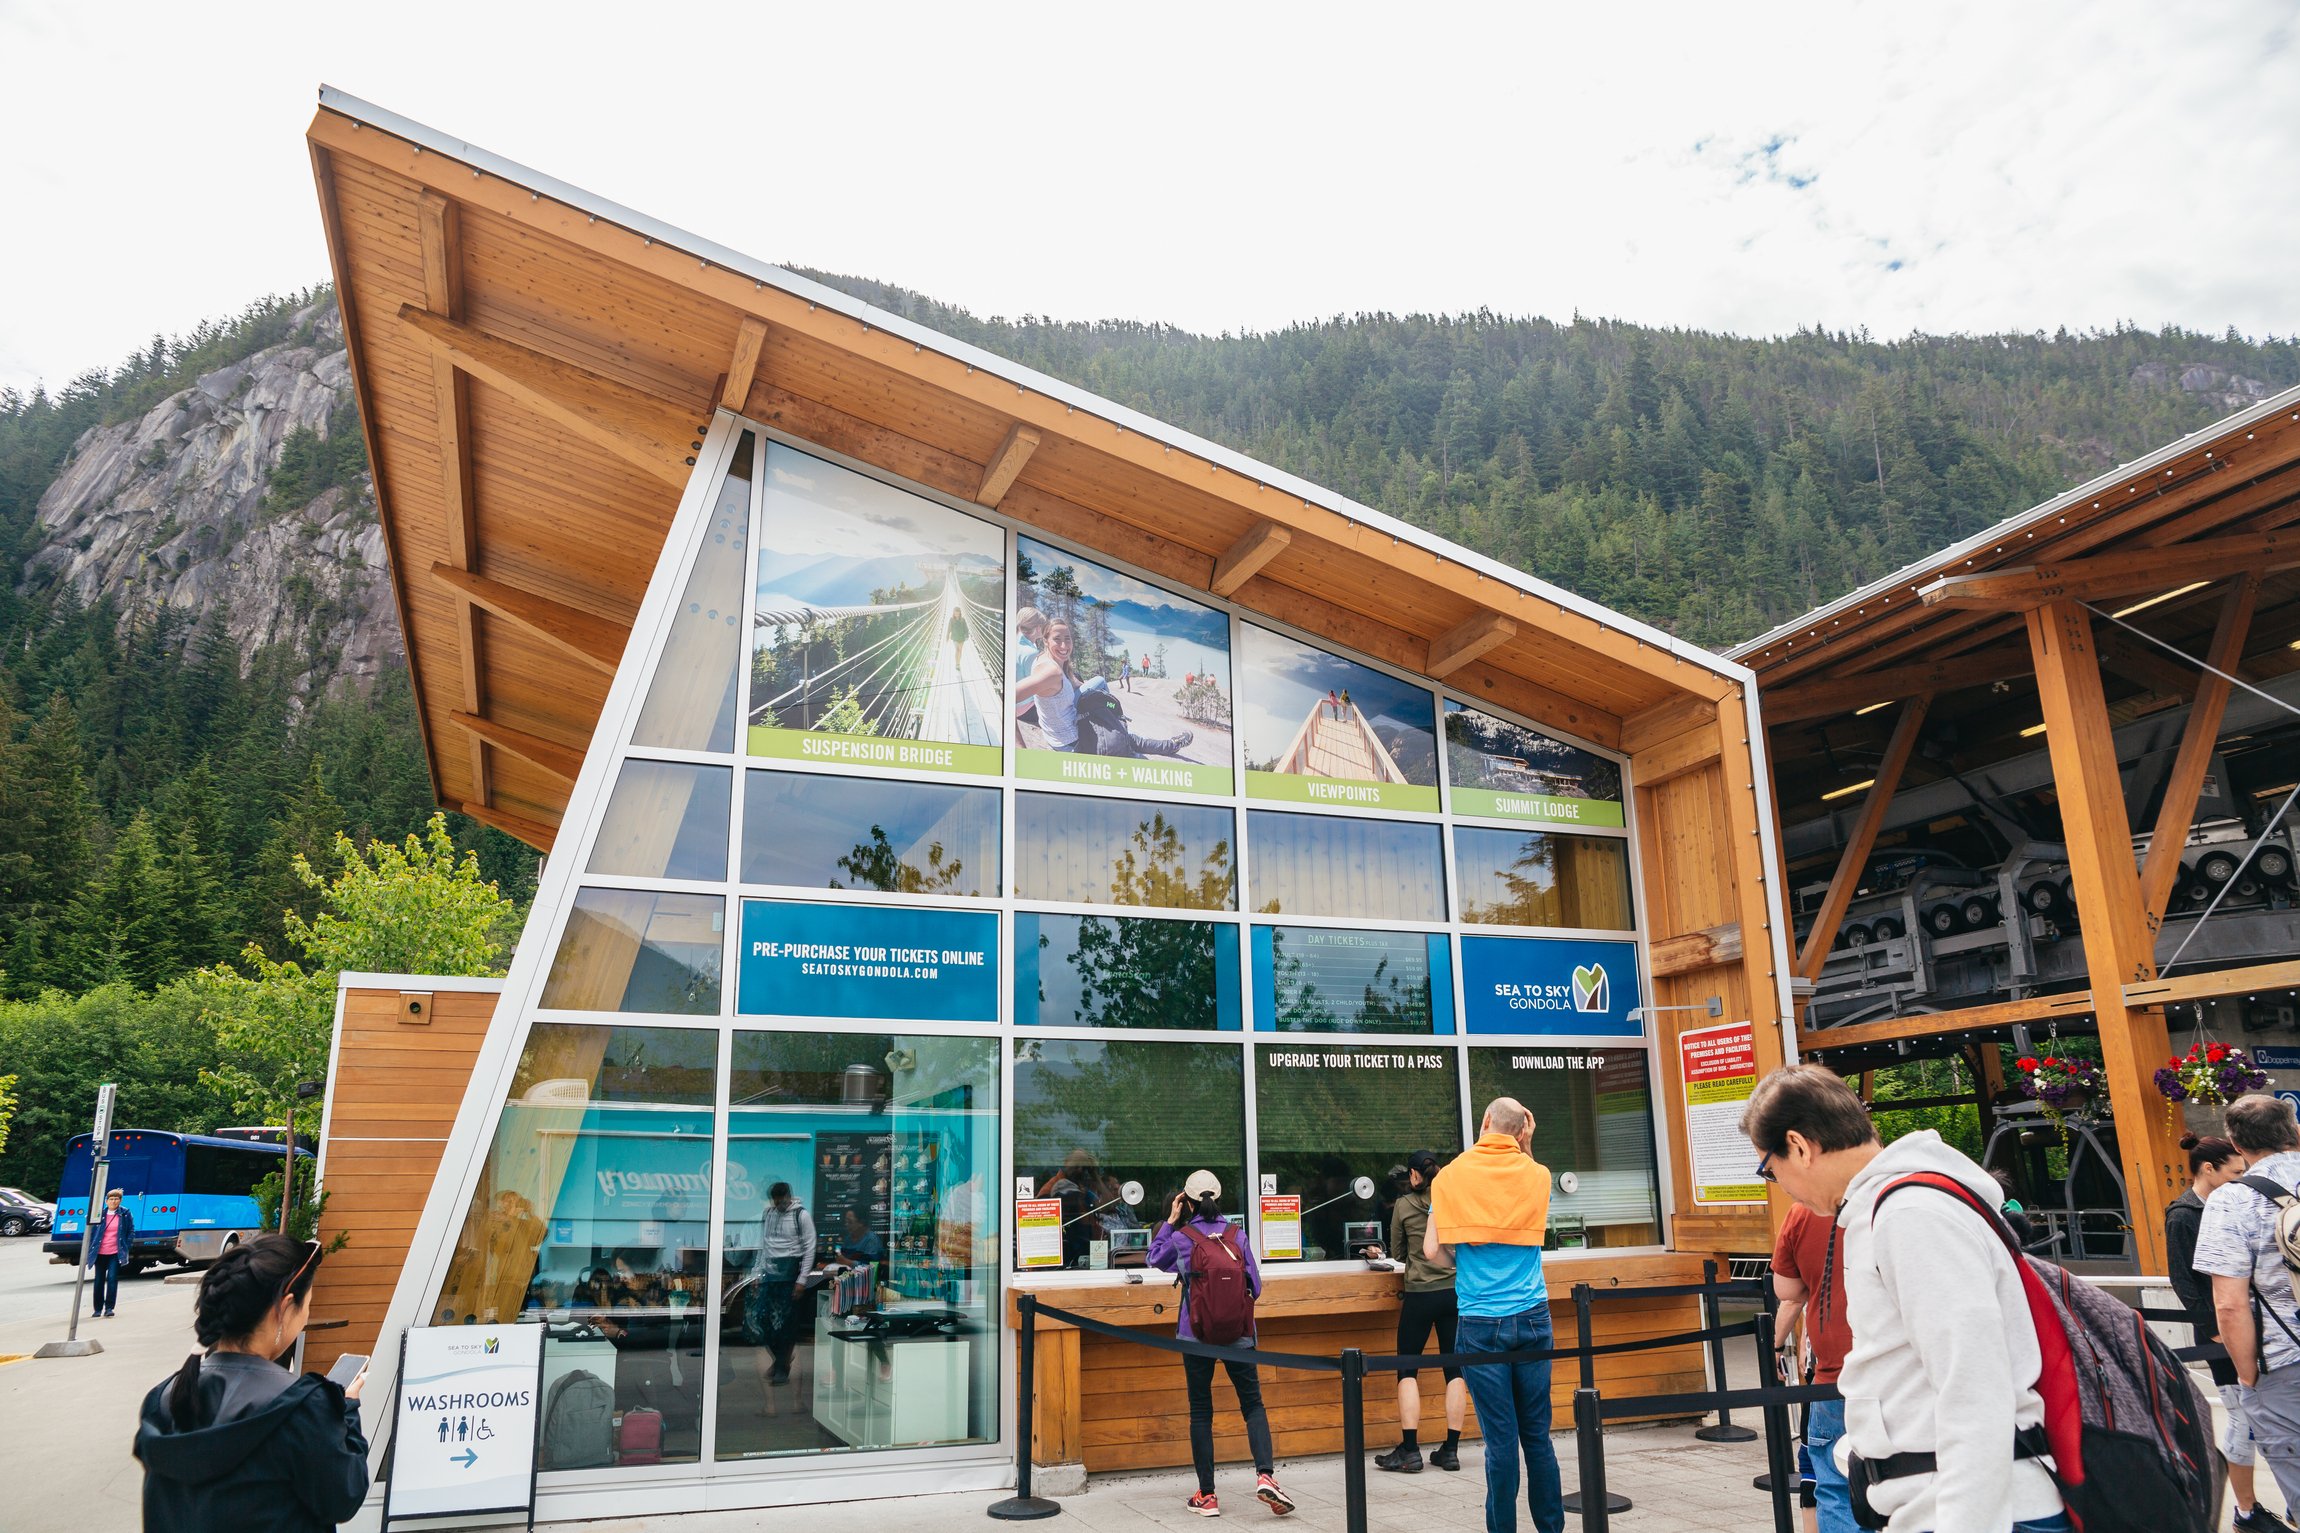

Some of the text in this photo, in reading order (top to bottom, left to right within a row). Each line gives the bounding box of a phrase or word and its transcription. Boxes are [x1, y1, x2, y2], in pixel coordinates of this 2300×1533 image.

[802, 738, 953, 766] SUSPENSION BRIDGE
[1062, 760, 1193, 787] HIKING + WALKING
[1307, 782, 1380, 802] VIEWPOINTS
[1496, 798, 1580, 819] SUMMIT LODGE
[1308, 935, 1365, 946] DAY TICKETS
[753, 942, 984, 966] PRE-PURCHASE YOUR TICKETS ONLINE
[801, 963, 938, 979] SEATOSKYGONDOLA.COM
[1495, 984, 1570, 998] SEA TO SKY
[1509, 998, 1572, 1010] GONDOLA
[1684, 1042, 1700, 1050] NOTICE
[1717, 1037, 1733, 1045] USERS
[1691, 1049, 1714, 1058] PREMISES
[1726, 1044, 1751, 1053] FACILITIES
[1269, 1053, 1442, 1068] UPGRADE YOUR TICKET TO A PASS
[1512, 1056, 1604, 1070] DOWNLOAD THE APP
[1694, 1081, 1711, 1090] PLEASE
[1726, 1077, 1753, 1086] CAREFULLY
[408, 1391, 530, 1411] WASHROOMS
